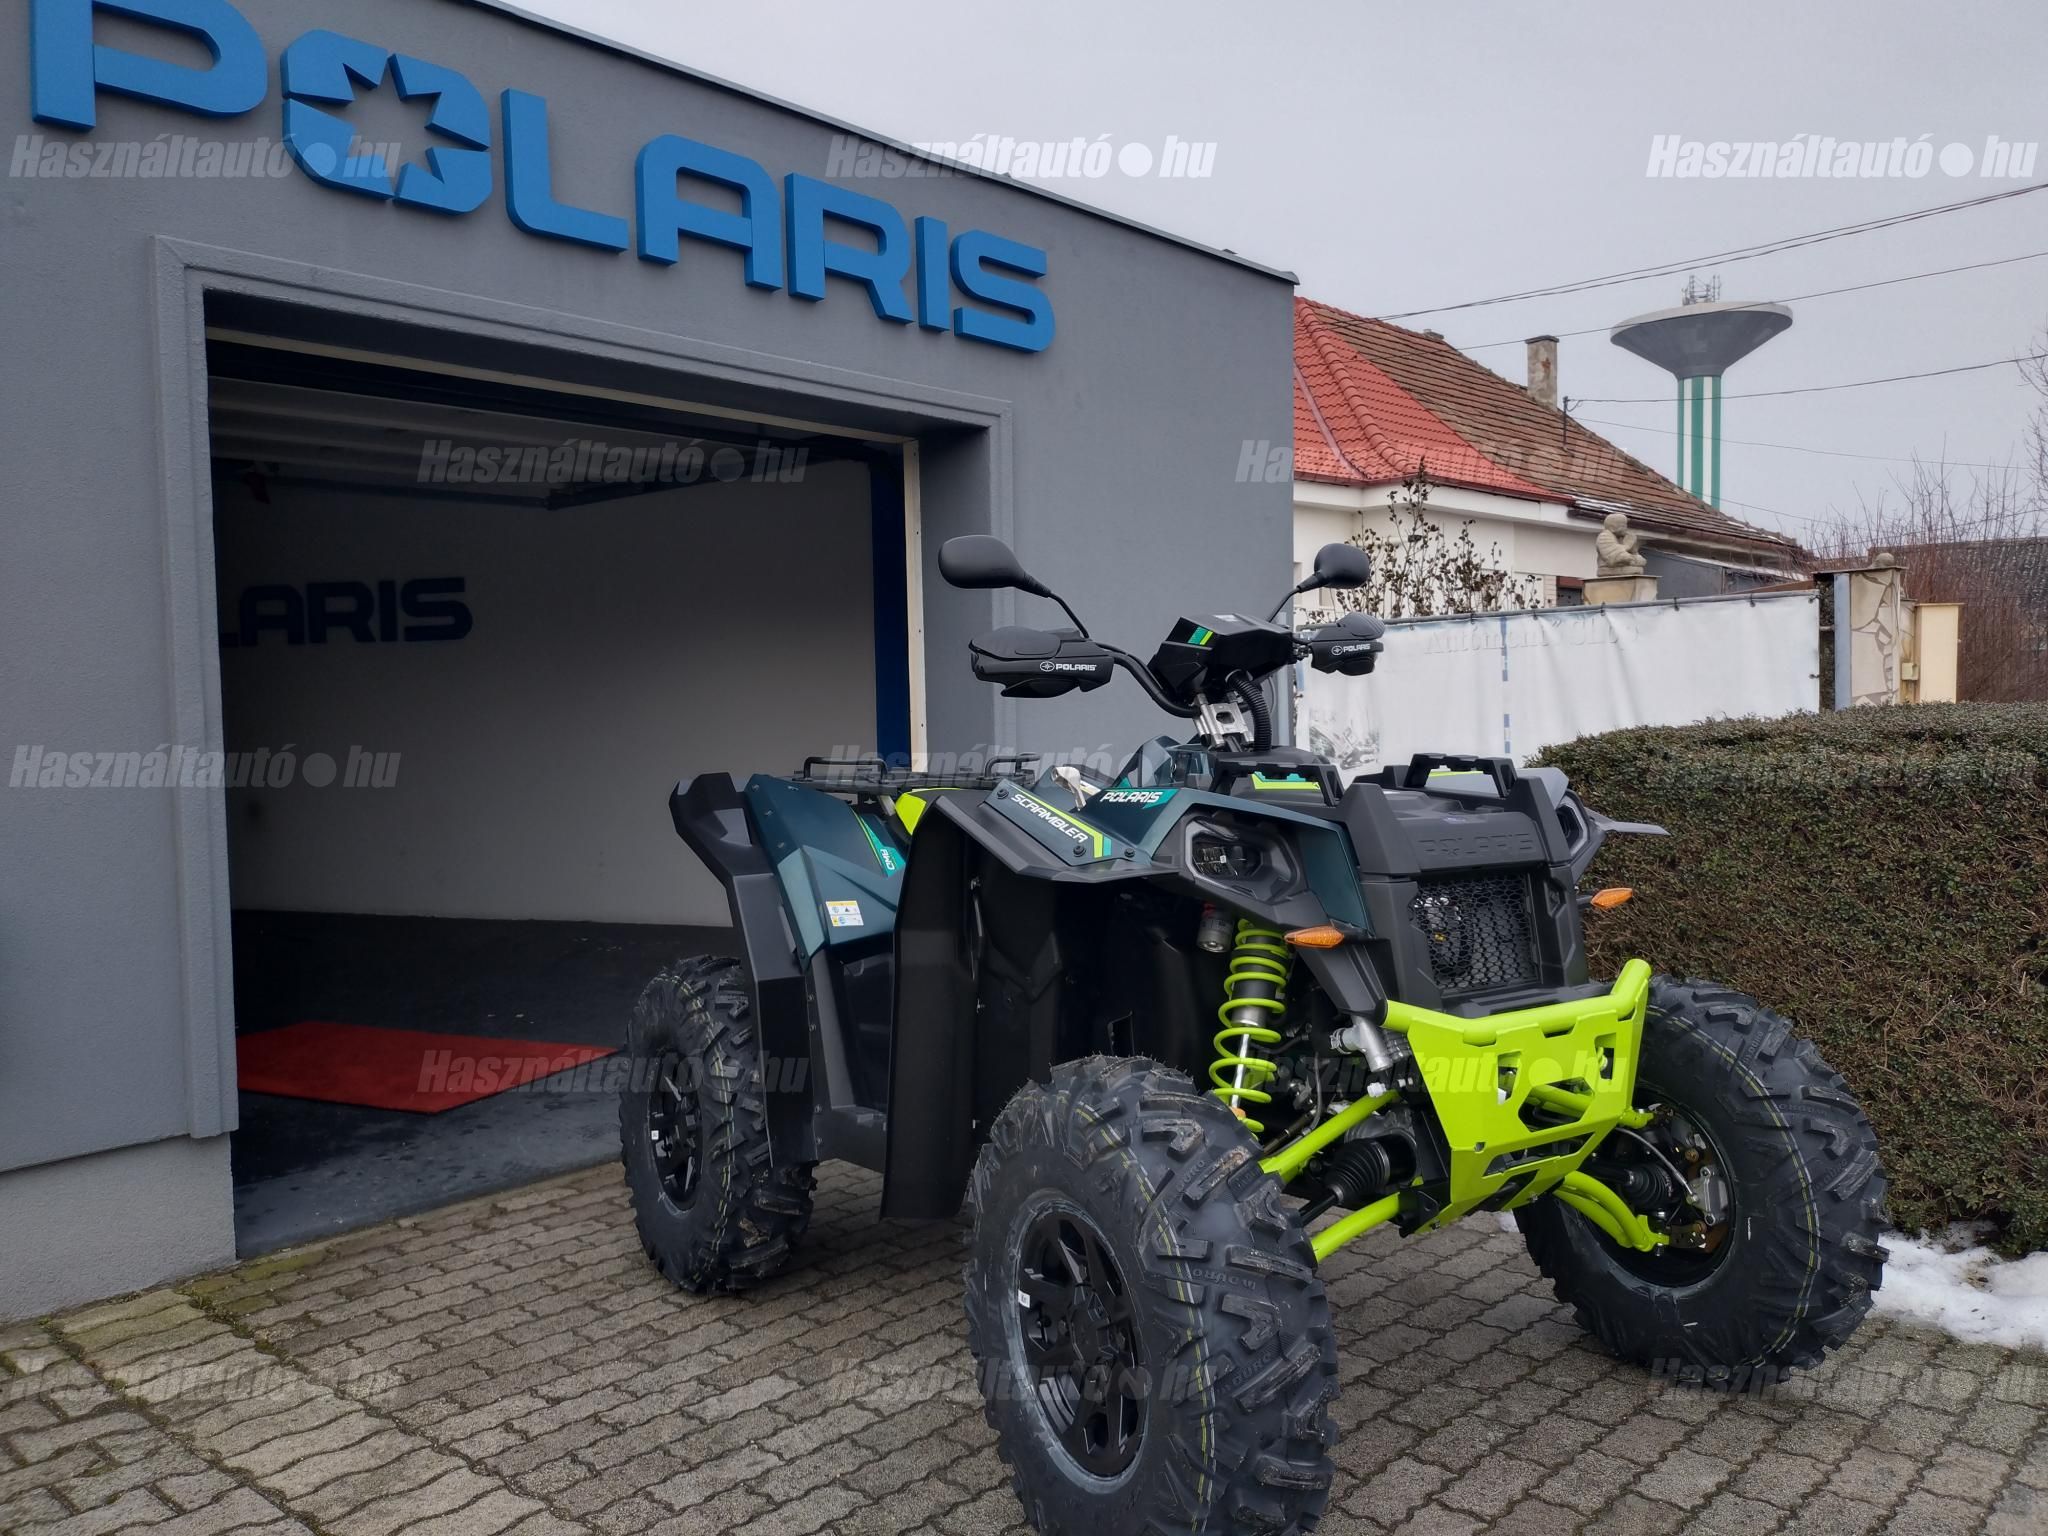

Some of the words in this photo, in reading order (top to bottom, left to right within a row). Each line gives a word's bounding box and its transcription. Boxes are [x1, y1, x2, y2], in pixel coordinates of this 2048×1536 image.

[31, 0, 1055, 353] POLARIS
[1055, 663, 1097, 671] POLARIS
[1099, 791, 1163, 803] POLARIS
[1010, 793, 1089, 843] SCRAMBLER
